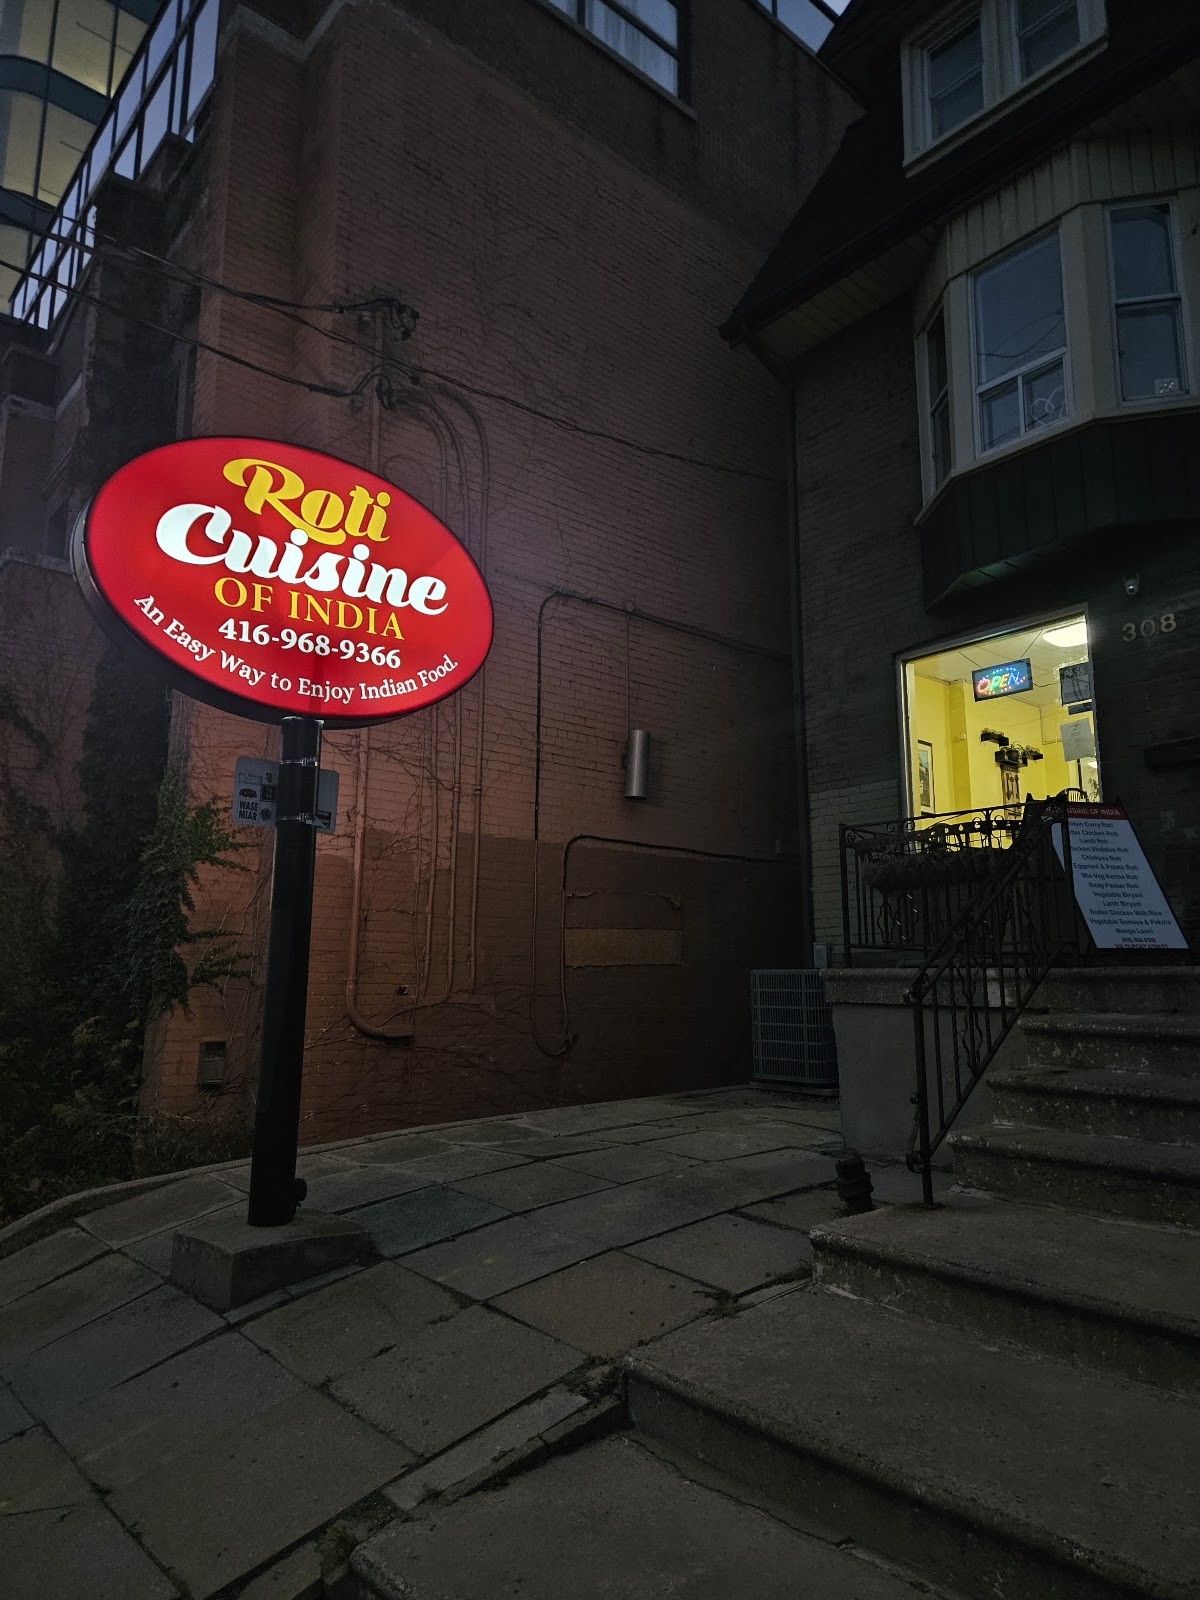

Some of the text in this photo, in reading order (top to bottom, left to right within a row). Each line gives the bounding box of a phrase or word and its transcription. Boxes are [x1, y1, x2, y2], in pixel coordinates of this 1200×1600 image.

[223, 458, 391, 545] Roti
[156, 503, 449, 615] Cuisine
[214, 577, 405, 640] OF INDIA
[1121, 613, 1177, 642] 308
[134, 595, 459, 704] An Easy Way to Enjoy Indian Food.
[218, 617, 401, 669] 416-968-9366
[976, 669, 1020, 693] OPEN
[1064, 667, 1086, 678] PASS
[1100, 808, 1121, 816] INDIA
[1073, 862, 1099, 870] Eggplant
